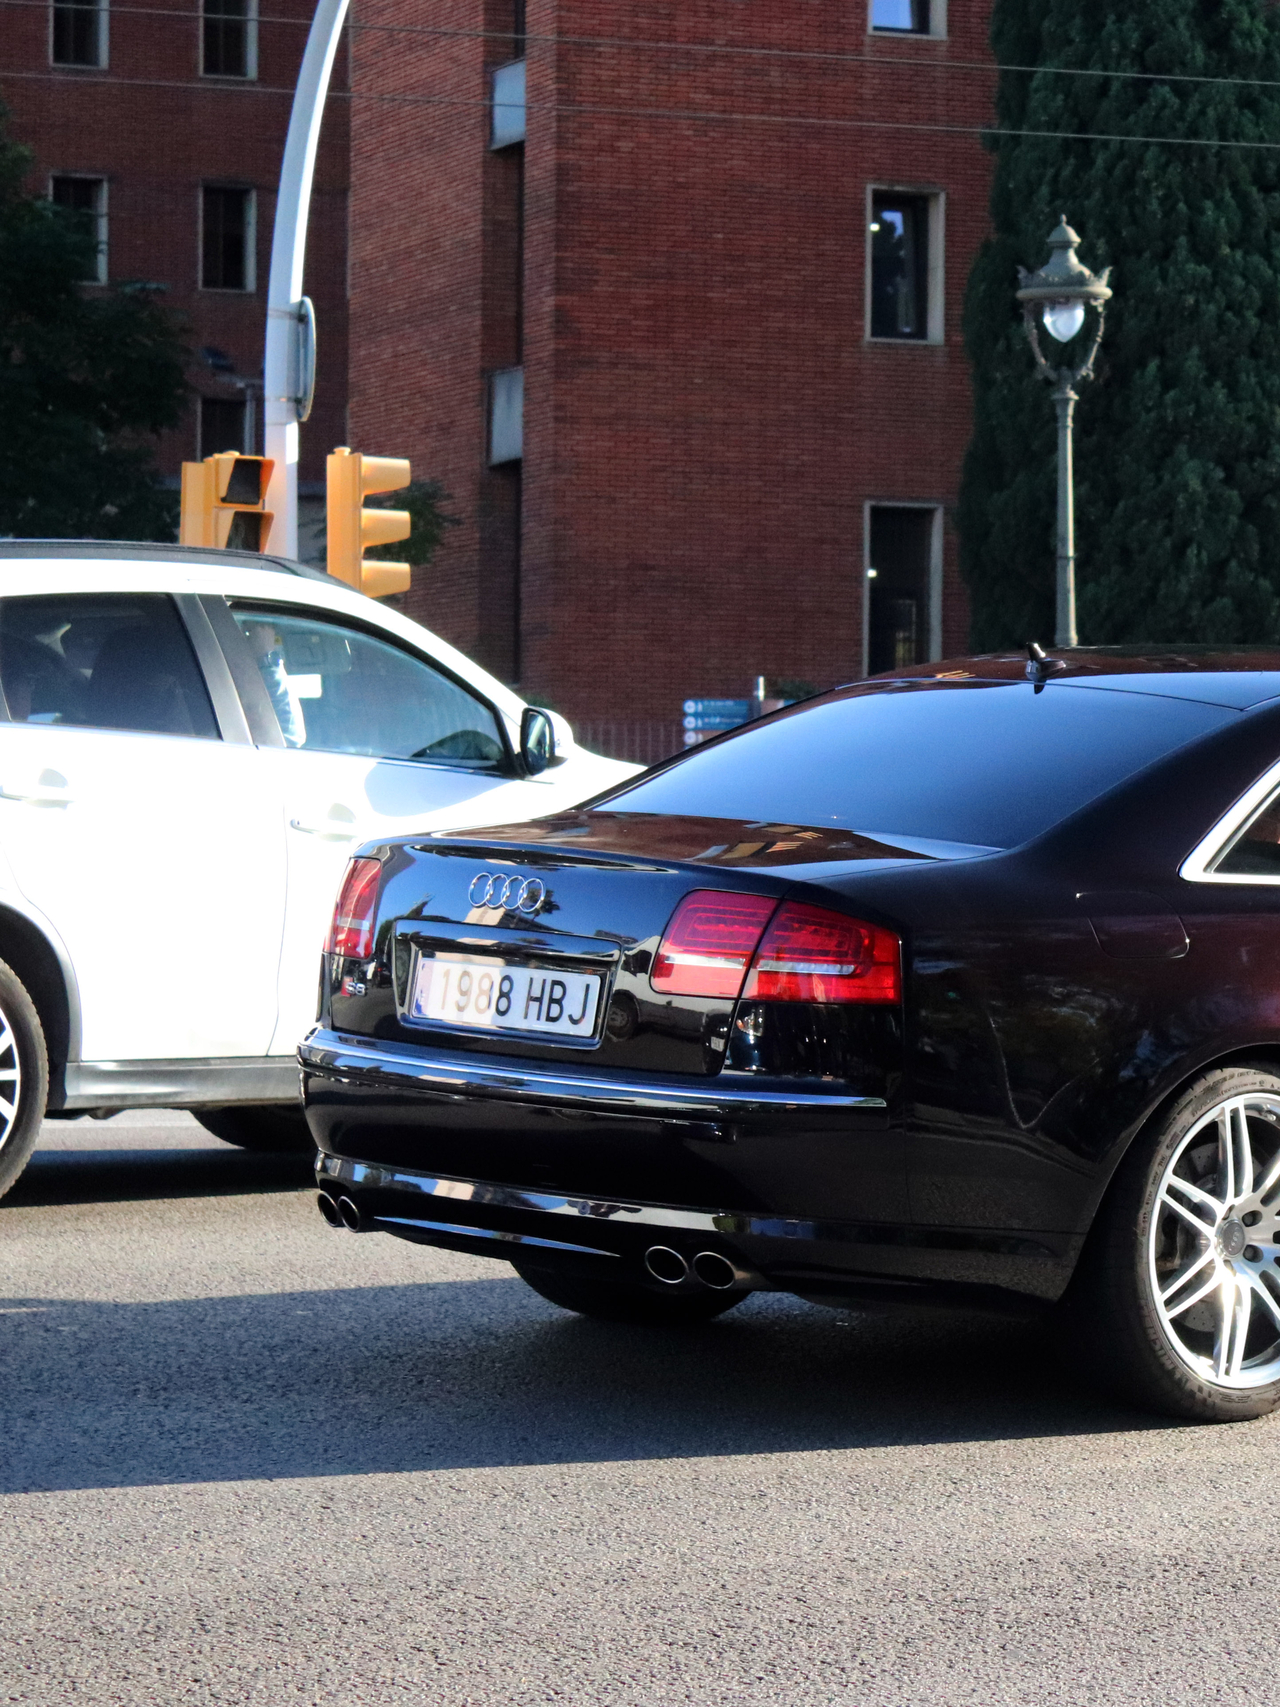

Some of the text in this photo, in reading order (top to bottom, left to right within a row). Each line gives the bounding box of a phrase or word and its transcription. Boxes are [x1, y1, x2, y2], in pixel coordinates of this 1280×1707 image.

[345, 981, 366, 997] S8
[440, 968, 515, 1017] 1988
[523, 976, 591, 1026] HBJ
